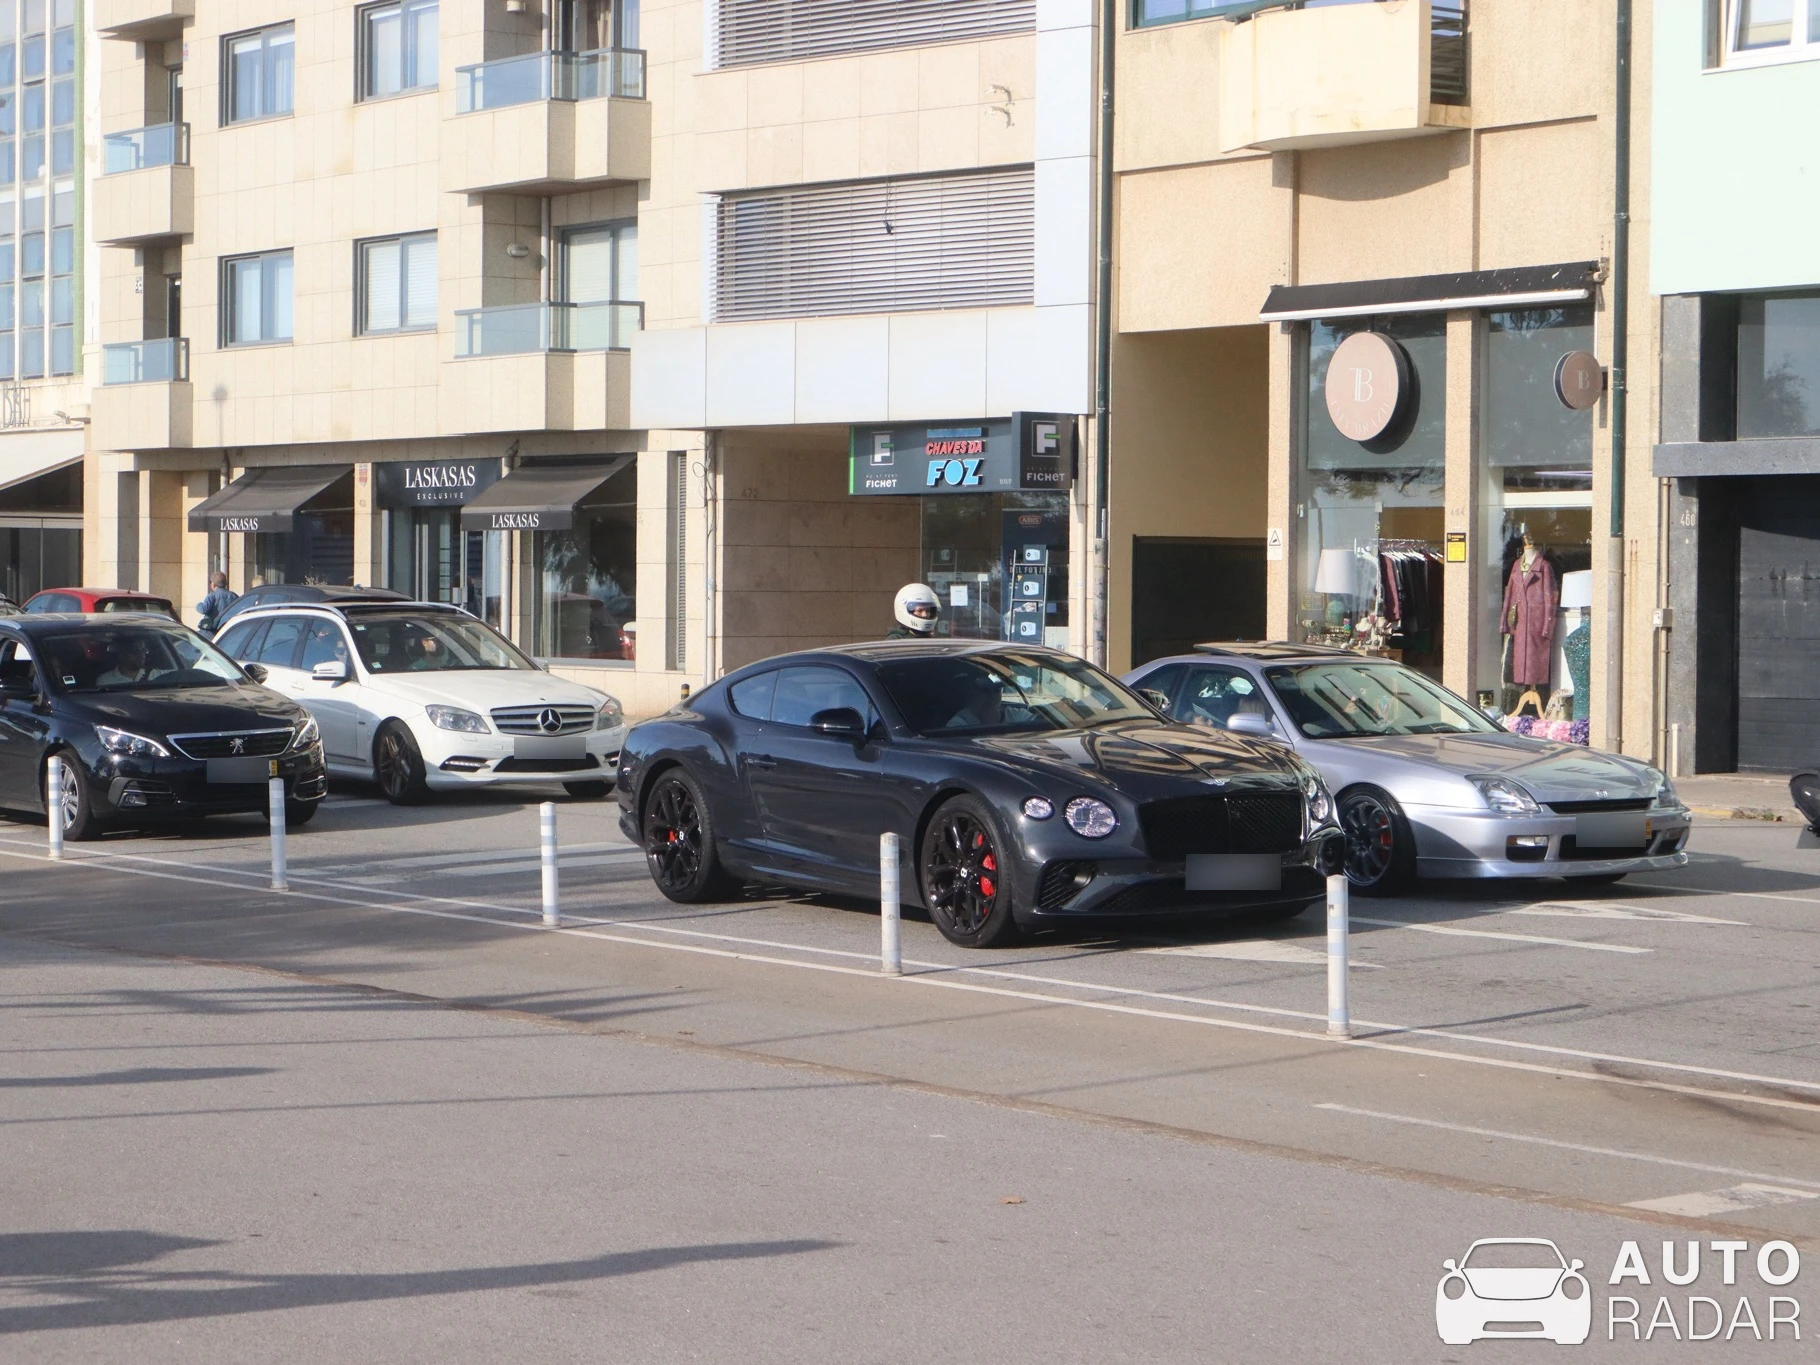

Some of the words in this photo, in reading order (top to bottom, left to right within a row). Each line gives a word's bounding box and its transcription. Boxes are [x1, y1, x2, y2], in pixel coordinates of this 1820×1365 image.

[925, 441, 967, 455] CHAVES
[968, 440, 983, 453] DA
[405, 466, 476, 488] LASKASAS
[926, 459, 981, 486] FOZ
[417, 492, 464, 500] EXCLUSIVE
[220, 518, 258, 530] LASKASAS
[492, 513, 539, 528] LASKASAS
[1680, 513, 1696, 526] 460
